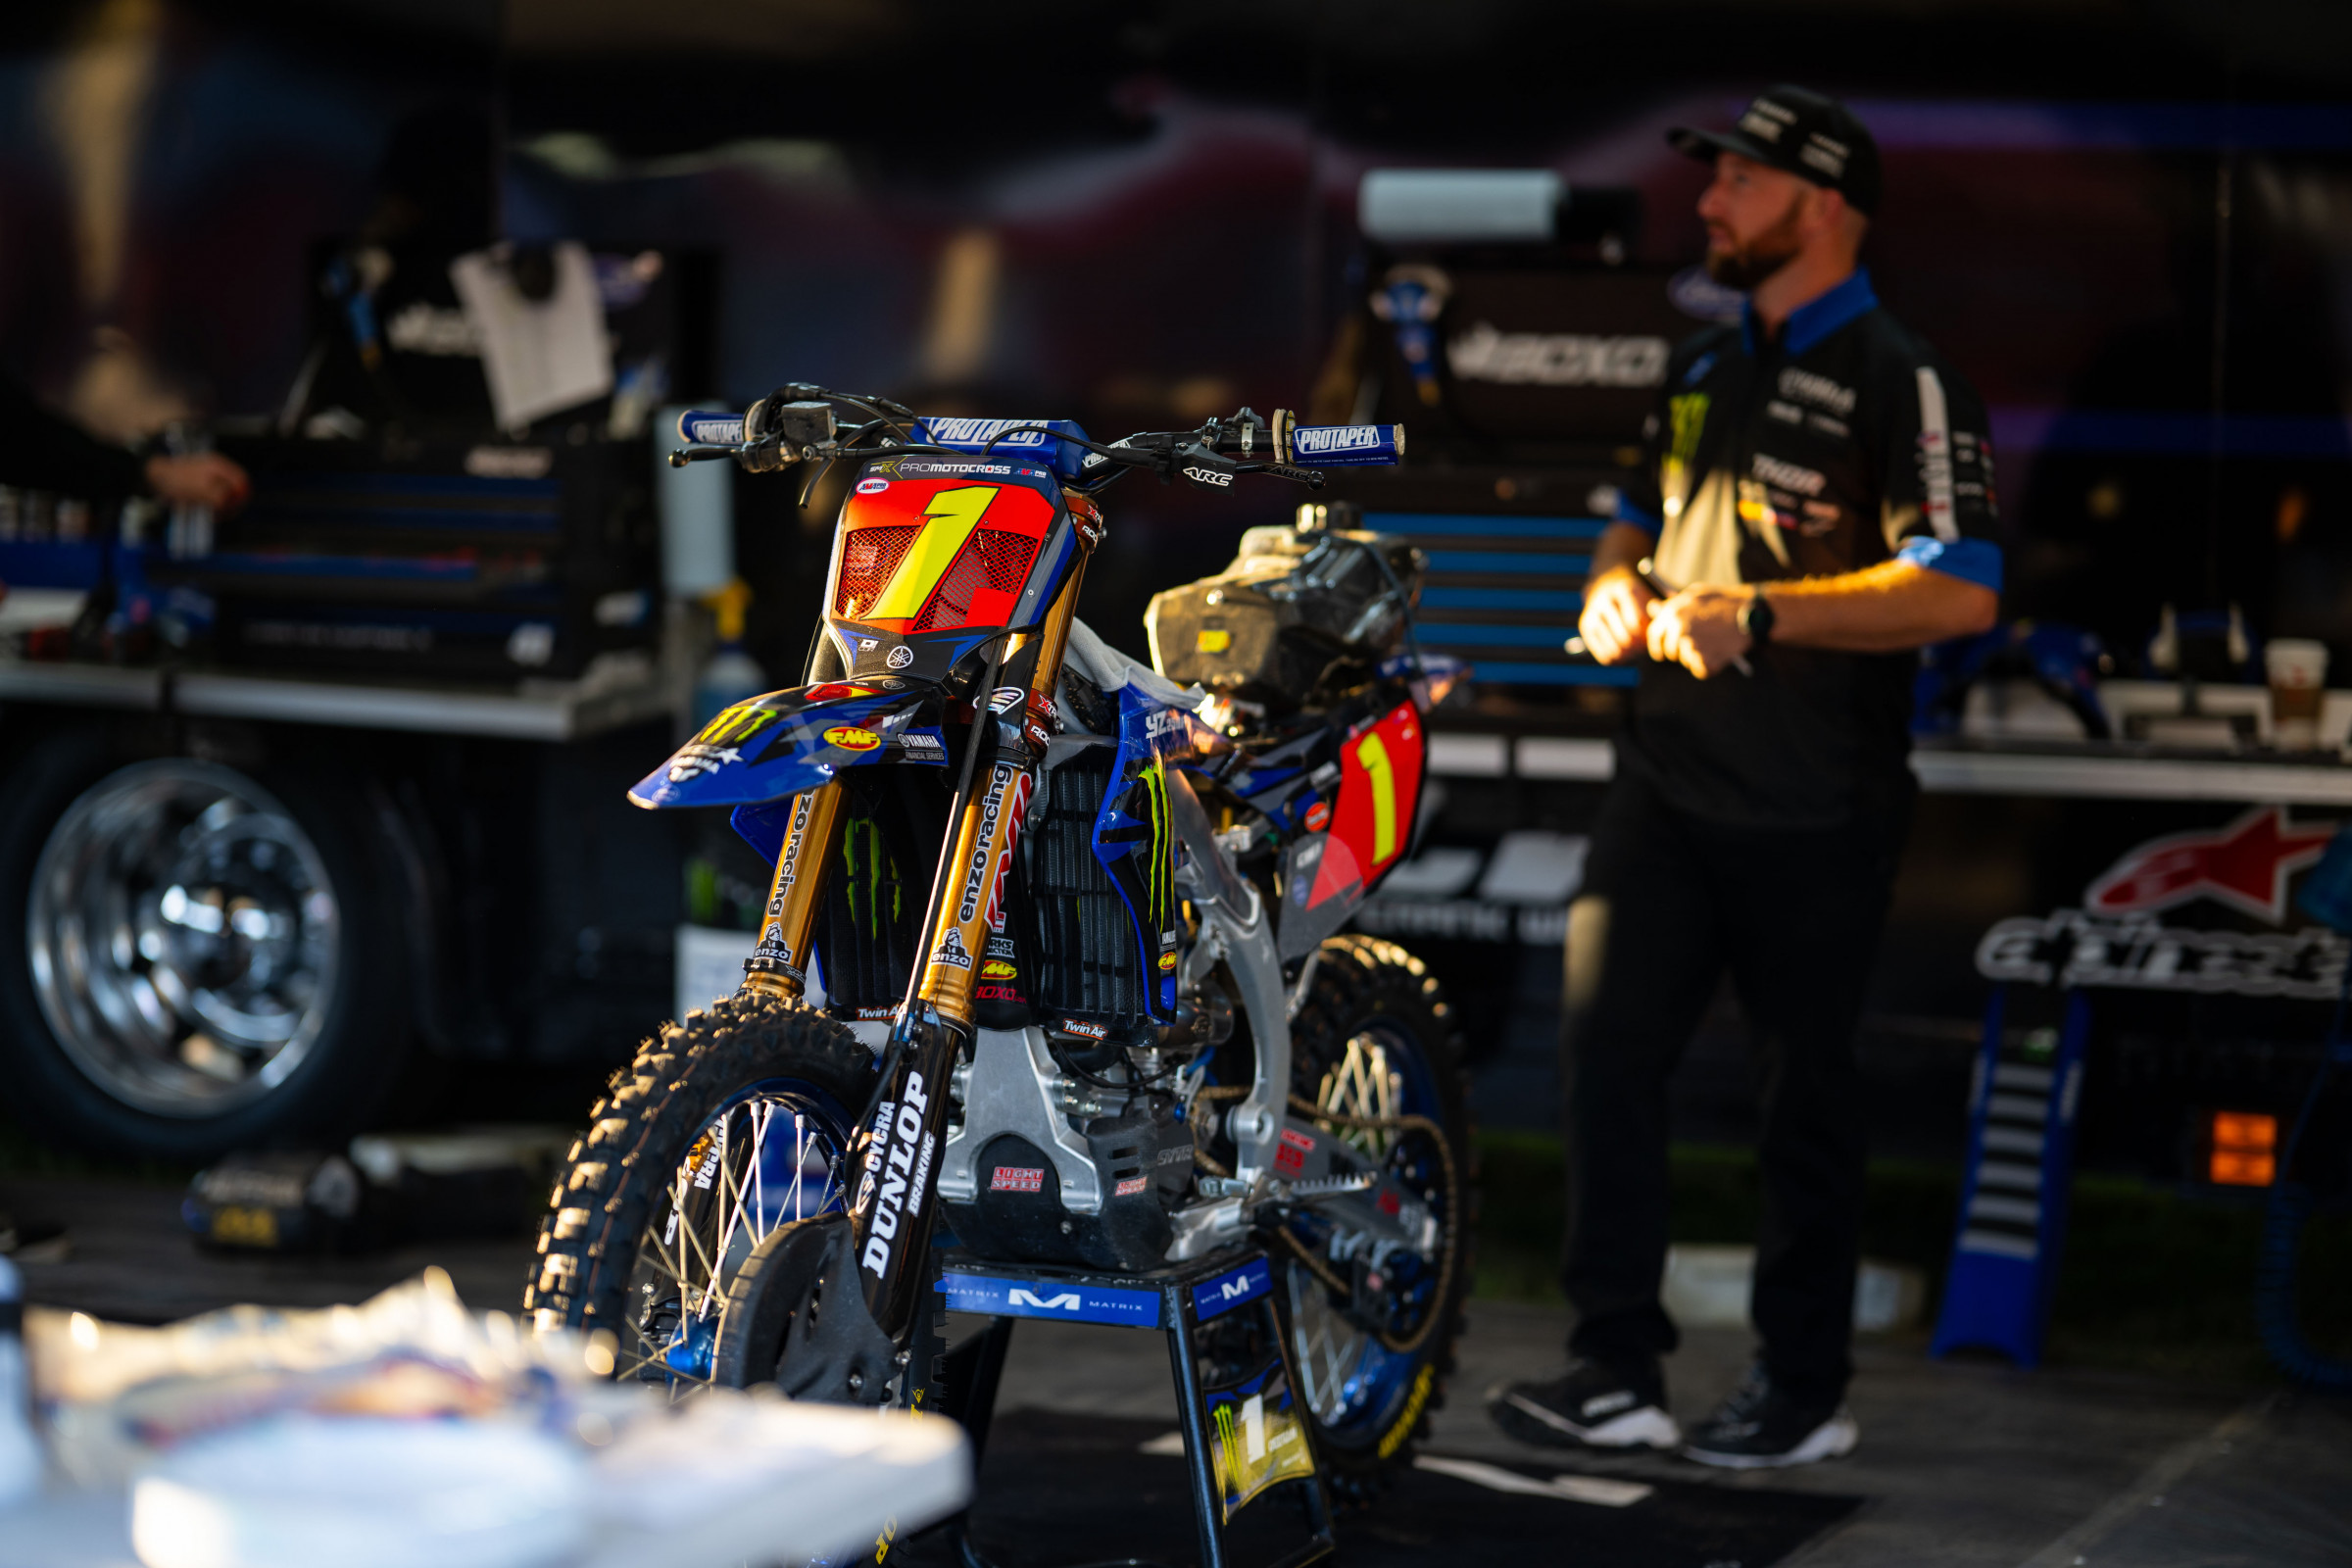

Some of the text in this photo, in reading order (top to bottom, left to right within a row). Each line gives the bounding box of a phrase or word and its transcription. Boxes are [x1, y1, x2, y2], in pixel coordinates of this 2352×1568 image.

[1300, 426, 1375, 451] PROTAPER
[1183, 466, 1234, 487] ARC
[859, 486, 1001, 621] 1
[827, 729, 878, 745] FMF
[906, 734, 941, 748] YAMAHA
[905, 750, 945, 760] FINANCIAL SERVICES
[1356, 731, 1396, 866] 1
[958, 849, 989, 923] enzo
[976, 764, 1013, 850] racing
[768, 833, 802, 916] racing
[756, 947, 789, 960] enzo
[932, 953, 969, 966] enzo
[858, 1006, 888, 1018] Twin
[1064, 1020, 1106, 1038] Twin Air
[865, 1101, 896, 1173] CYCRA
[862, 1070, 928, 1280] DUNLOP
[907, 1132, 935, 1217] BRAKING
[992, 1179, 1041, 1190] SPEED
[996, 1168, 1044, 1179] LIGHT
[947, 1287, 1000, 1298] MATRIX
[1089, 1299, 1143, 1311] MATRIX
[1240, 1393, 1265, 1465] 1
